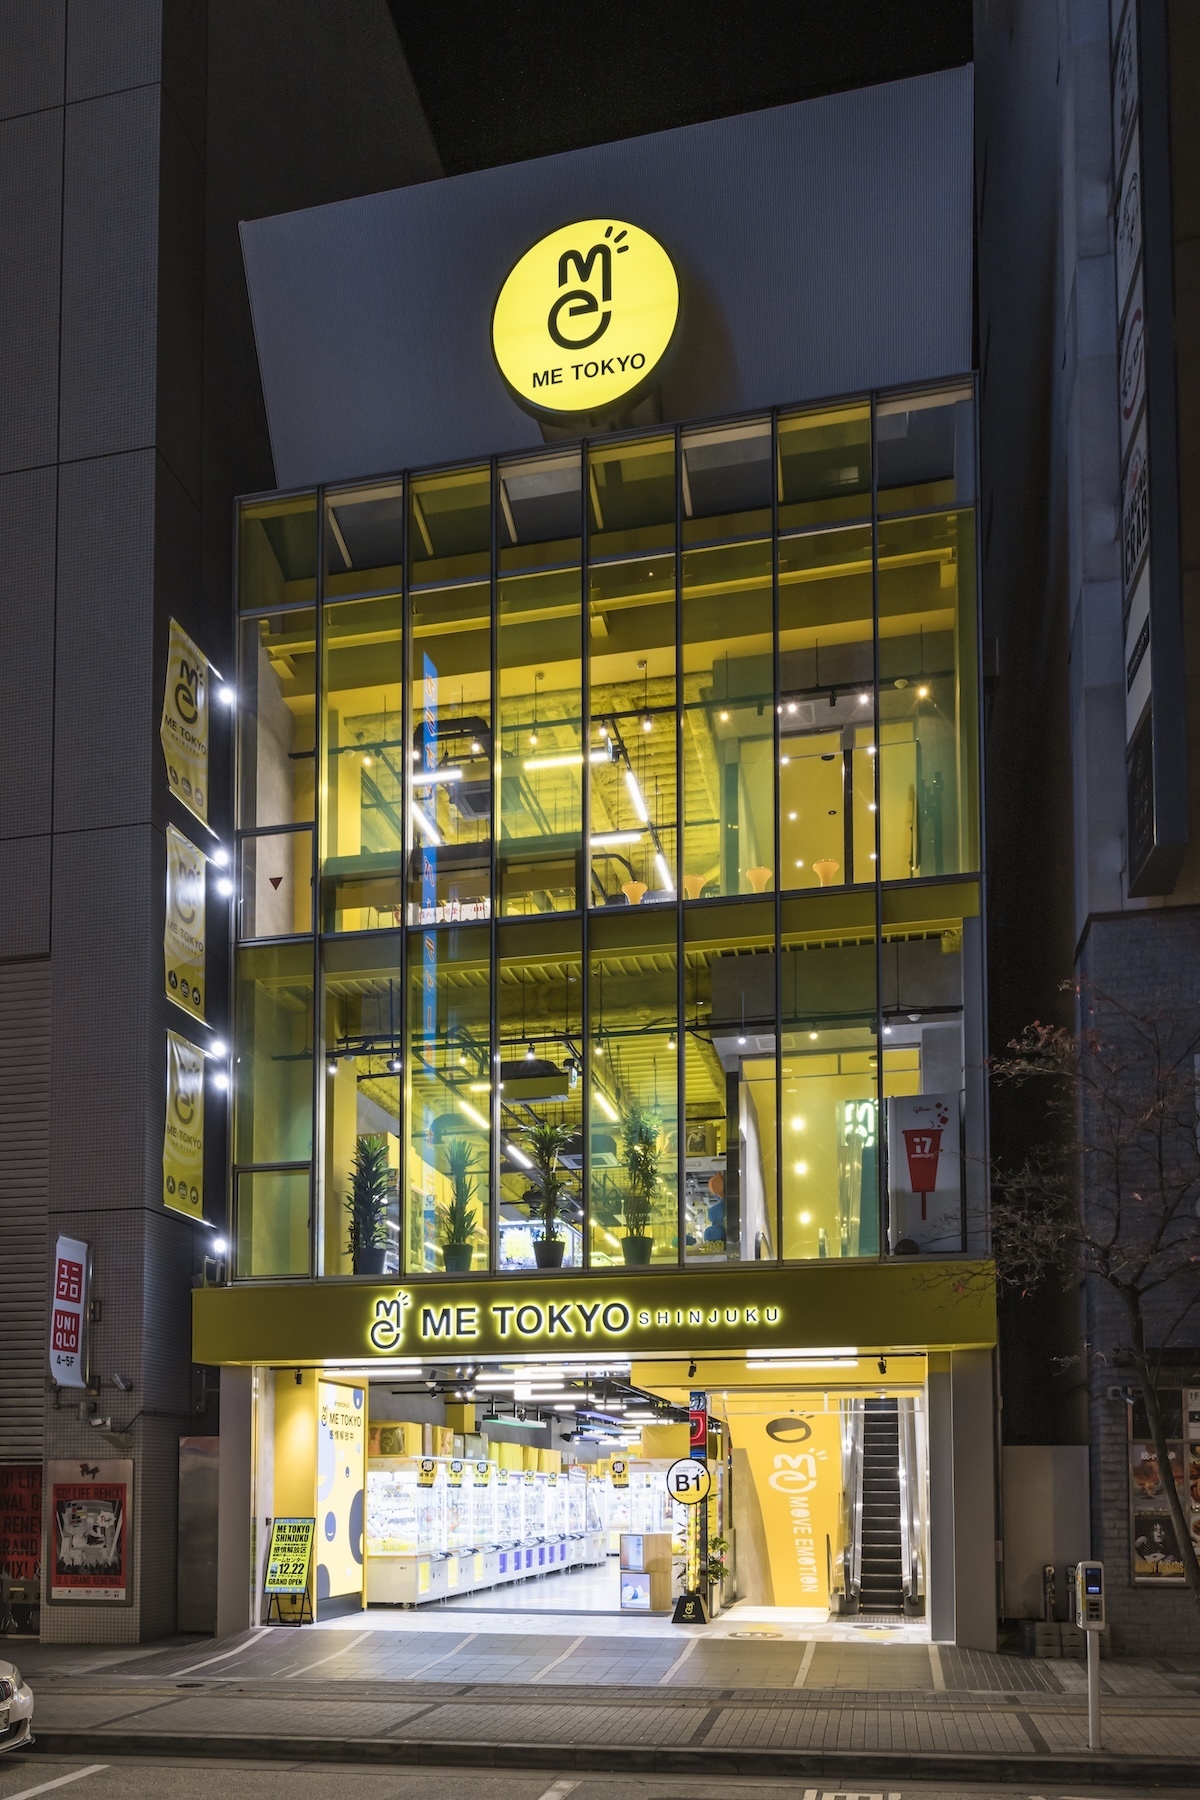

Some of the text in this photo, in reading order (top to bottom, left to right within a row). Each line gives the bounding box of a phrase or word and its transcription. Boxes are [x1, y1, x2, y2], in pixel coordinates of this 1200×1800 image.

[532, 353, 646, 388] ME TOKYO
[1125, 488, 1147, 586] CRAB
[165, 715, 207, 755] ME TOKYO
[180, 929, 204, 952] TOKYO
[179, 1130, 202, 1150] TOKYO
[61, 1265, 79, 1281] ユニ
[58, 1282, 79, 1298] クロ
[57, 1315, 75, 1331] UNI
[422, 1308, 477, 1337] ME
[492, 1302, 630, 1335] TOKYO
[639, 1308, 779, 1325] SHINJUKU
[55, 1333, 76, 1349] QLO
[330, 1413, 339, 1425] ME
[341, 1415, 361, 1427] TOKYO
[19, 1472, 41, 1488] LIF
[675, 1474, 700, 1492] B1
[74, 1487, 90, 1498] LIFE
[94, 1486, 122, 1497] REMIX!
[4, 1516, 40, 1533] RENE
[277, 1525, 310, 1533] ME TOKYO
[275, 1534, 309, 1542] SHINJUKU
[789, 1496, 819, 1594] MOVE EMOTION
[279, 1563, 305, 1575] 12.22
